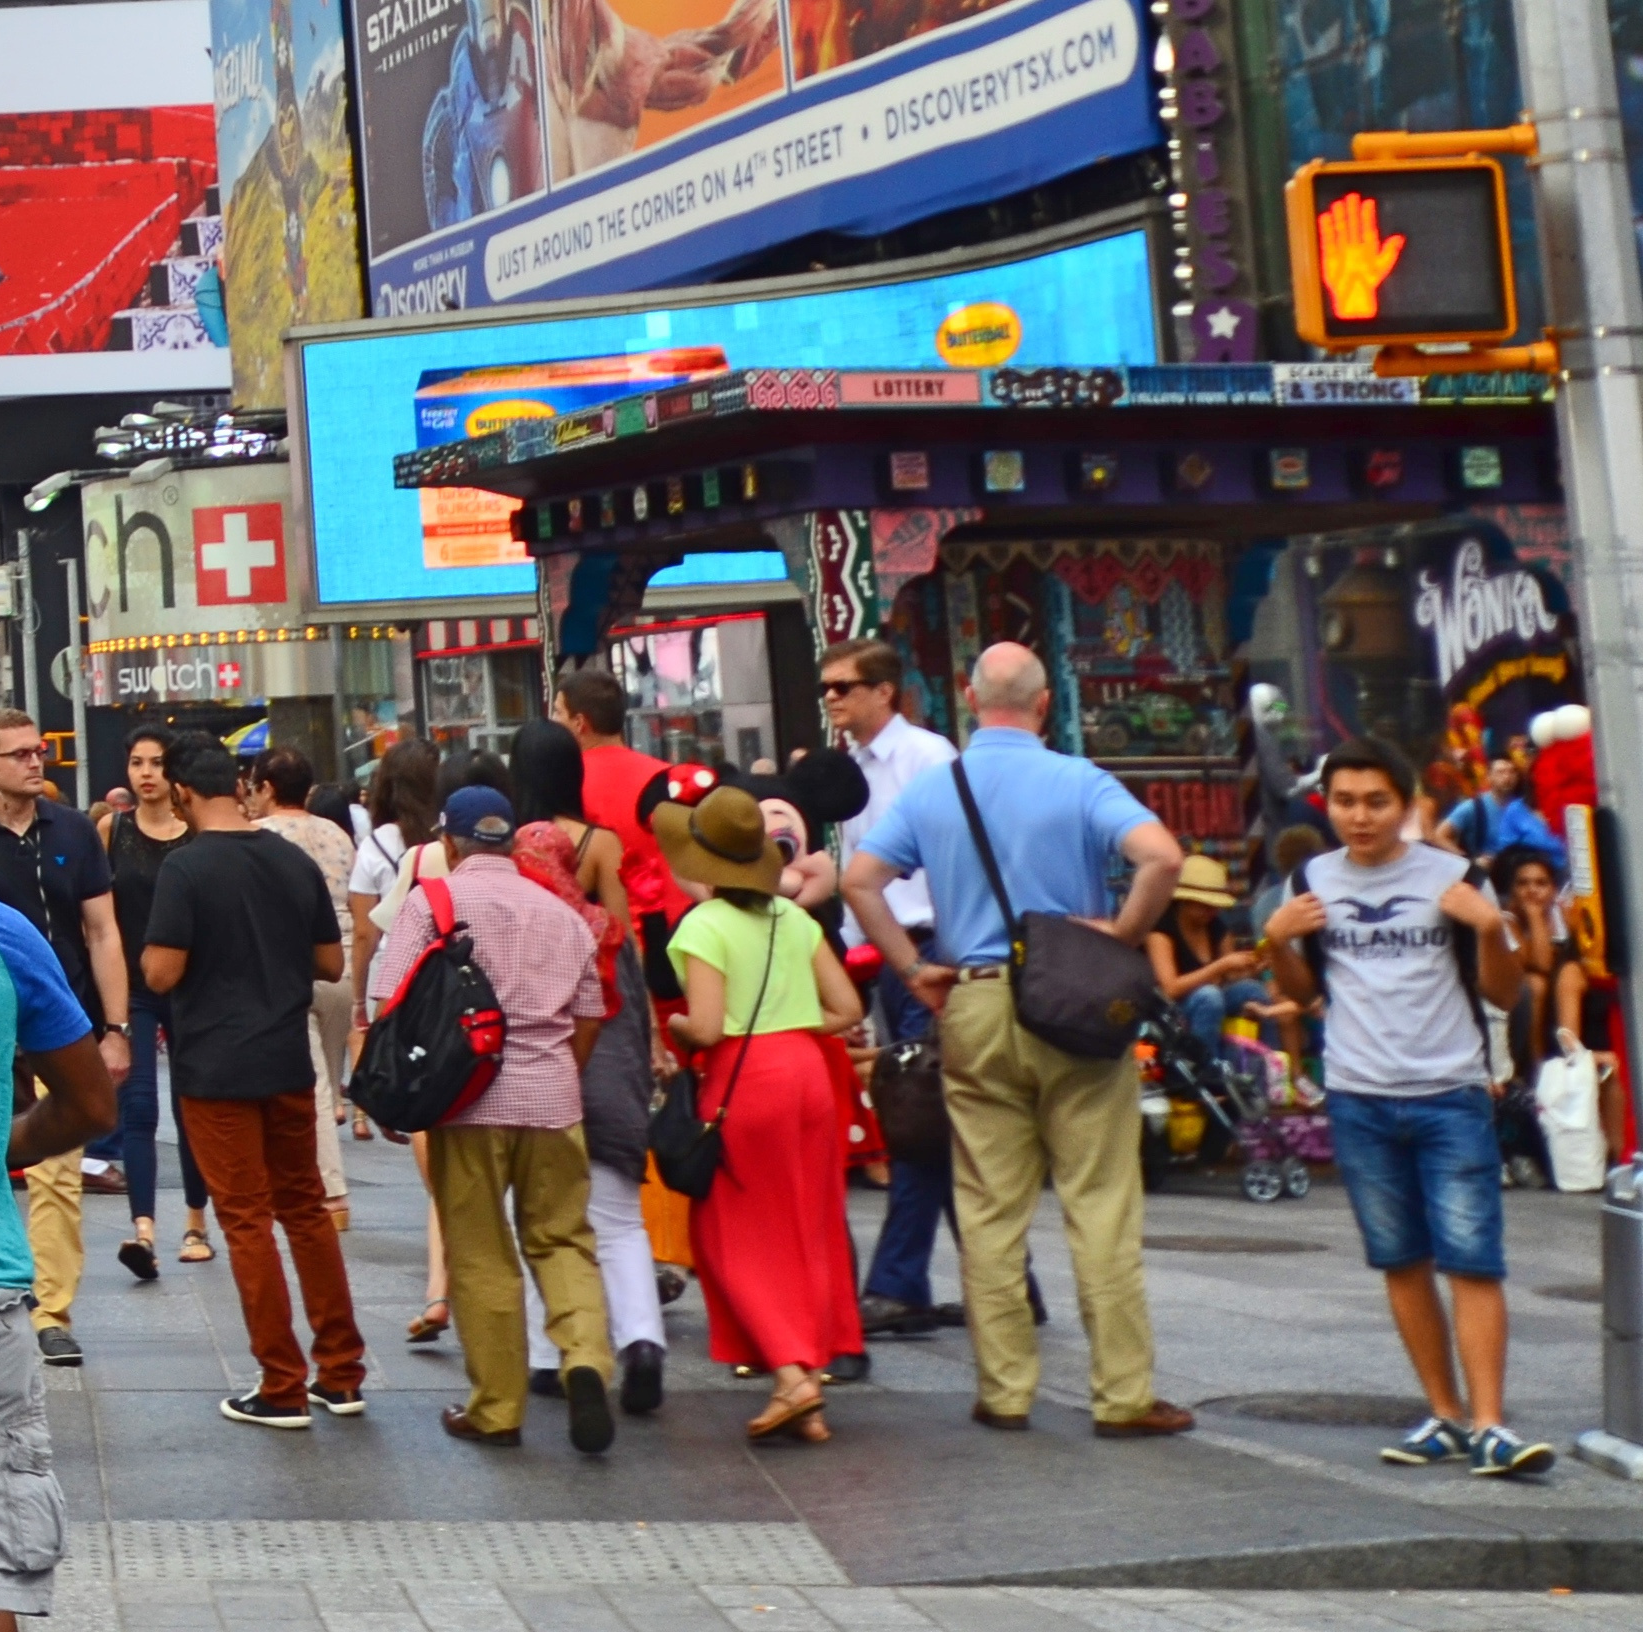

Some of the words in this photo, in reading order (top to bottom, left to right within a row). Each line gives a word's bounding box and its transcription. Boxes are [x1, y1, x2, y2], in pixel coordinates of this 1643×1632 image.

[382, 24, 450, 74] EXHIBITION
[886, 24, 1115, 141] DISCOVERYTSX.COM
[497, 245, 527, 282] JUST
[532, 221, 592, 271] AROUND
[599, 210, 628, 246] THE
[632, 187, 696, 236] CORNER
[702, 176, 727, 210] ON
[733, 153, 768, 195] 44TH
[773, 123, 844, 179] STREET
[872, 378, 947, 399] LOTTERY
[1316, 380, 1406, 402] STRONG
[118, 657, 216, 695] swatch
